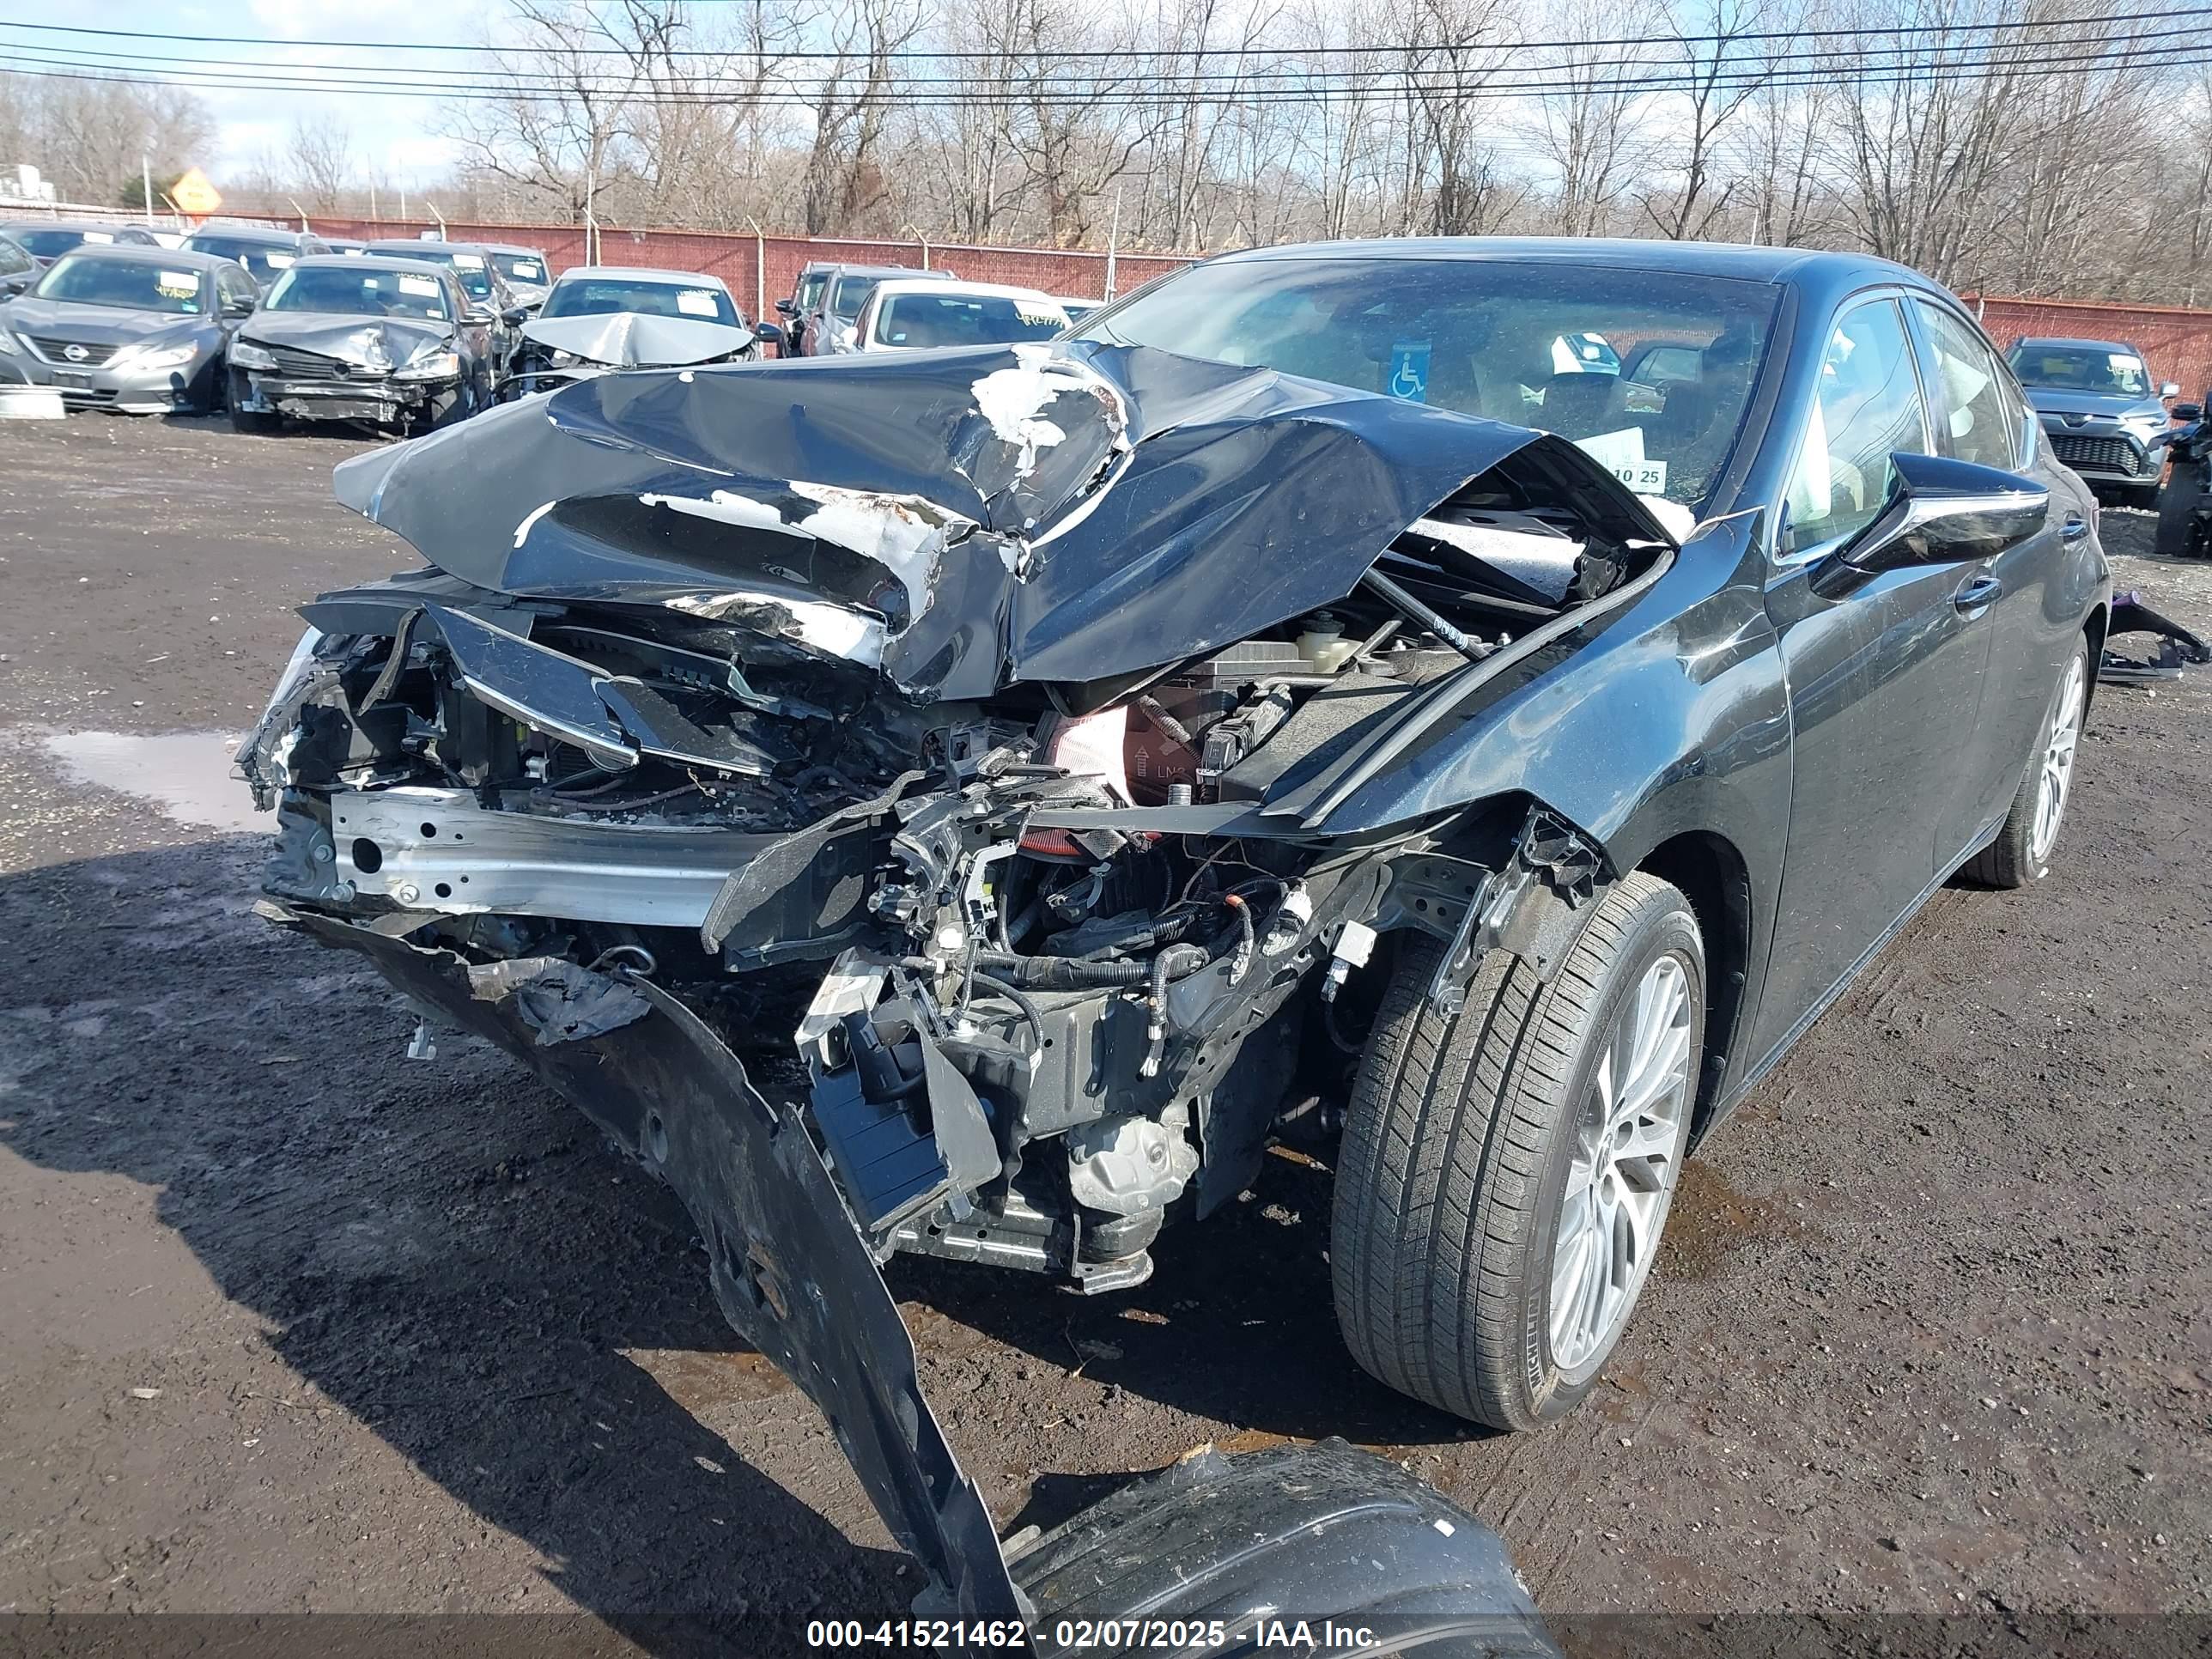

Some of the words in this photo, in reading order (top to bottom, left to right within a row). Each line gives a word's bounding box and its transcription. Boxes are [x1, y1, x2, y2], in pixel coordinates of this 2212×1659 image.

[1614, 469, 1633, 482] 10
[1640, 471, 1659, 483] 25
[1527, 1297, 1543, 1389] MICHELIN
